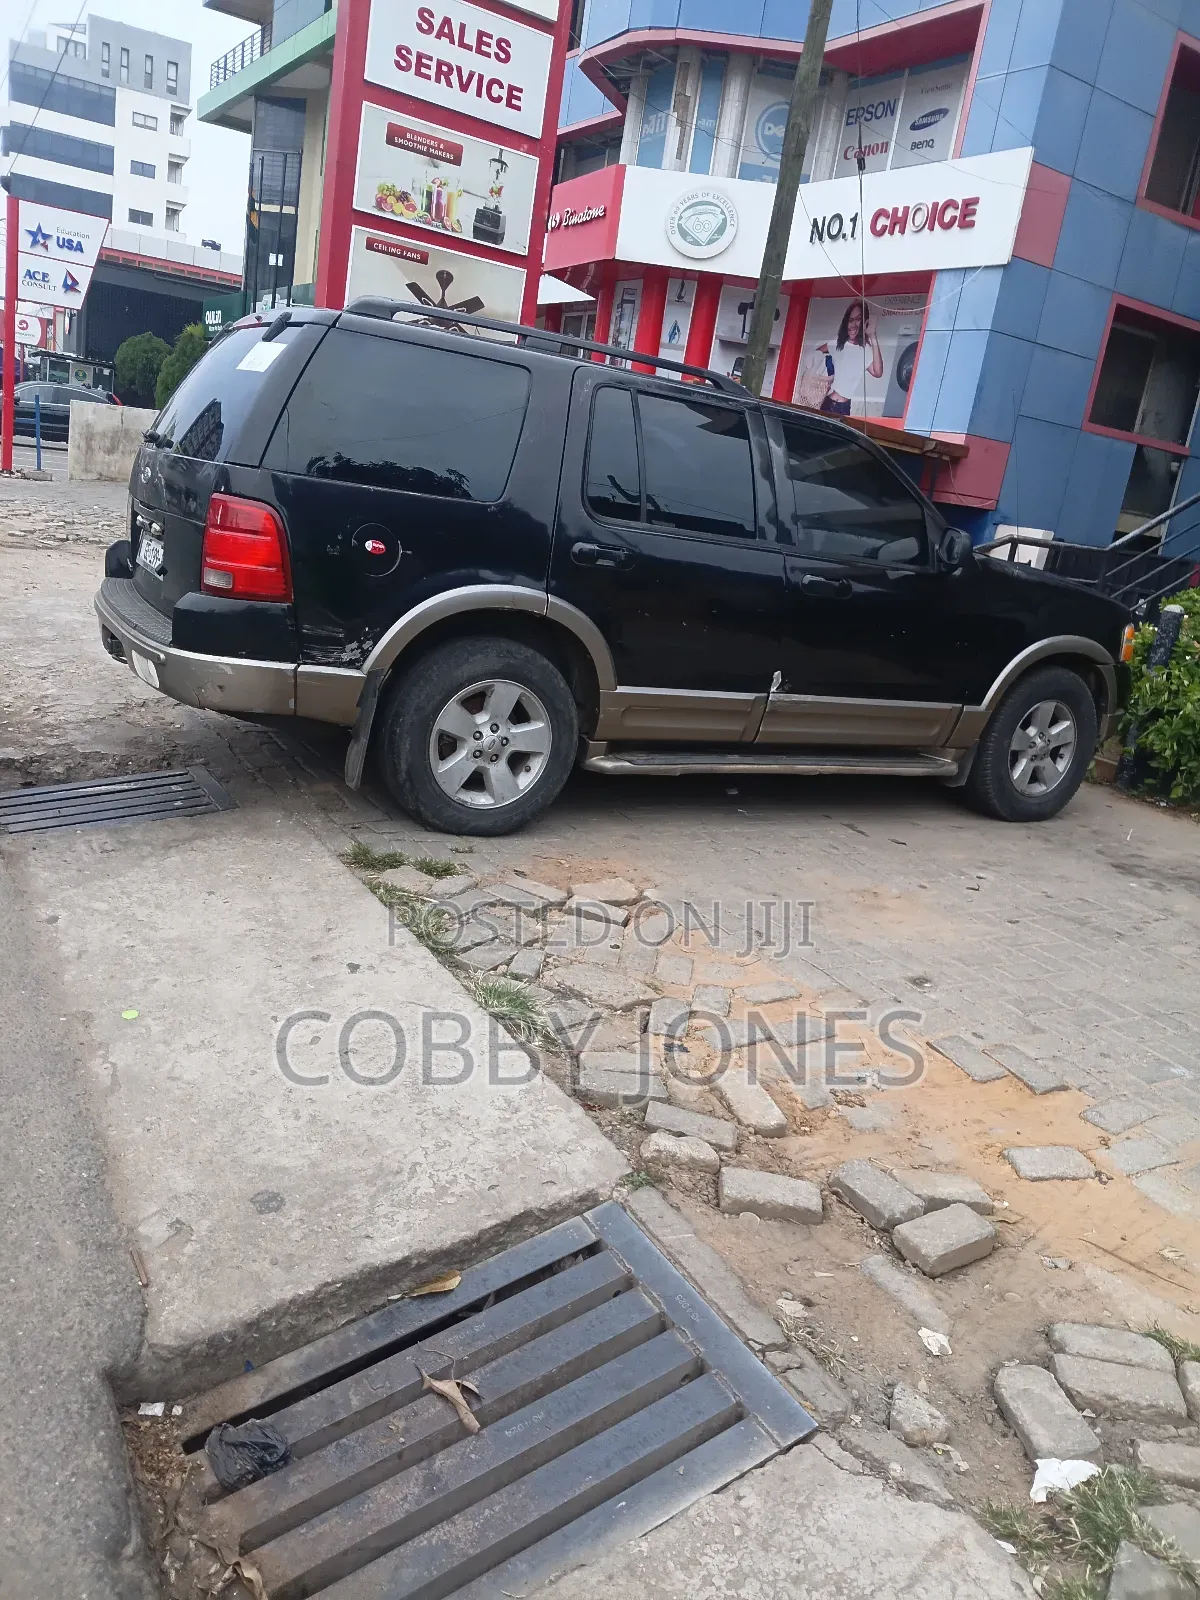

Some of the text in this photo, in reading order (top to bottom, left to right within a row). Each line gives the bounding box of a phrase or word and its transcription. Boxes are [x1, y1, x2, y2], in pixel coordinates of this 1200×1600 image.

[415, 6, 512, 64] SALES
[393, 44, 524, 112] SERVICE
[845, 97, 899, 127] EPSON
[394, 136, 454, 160] SMOOTHIE MAKERS
[406, 132, 438, 148] BLENDERS
[843, 140, 890, 161] Canon
[679, 192, 699, 206] YEARS
[712, 193, 736, 228] EXCELLENCE
[809, 196, 981, 245] NO.1 CHOICE
[56, 226, 90, 240] Education
[56, 235, 85, 254] USA
[373, 242, 421, 261] CEILING FANS
[21, 279, 57, 292] CONSULT
[23, 268, 50, 283] ACE
